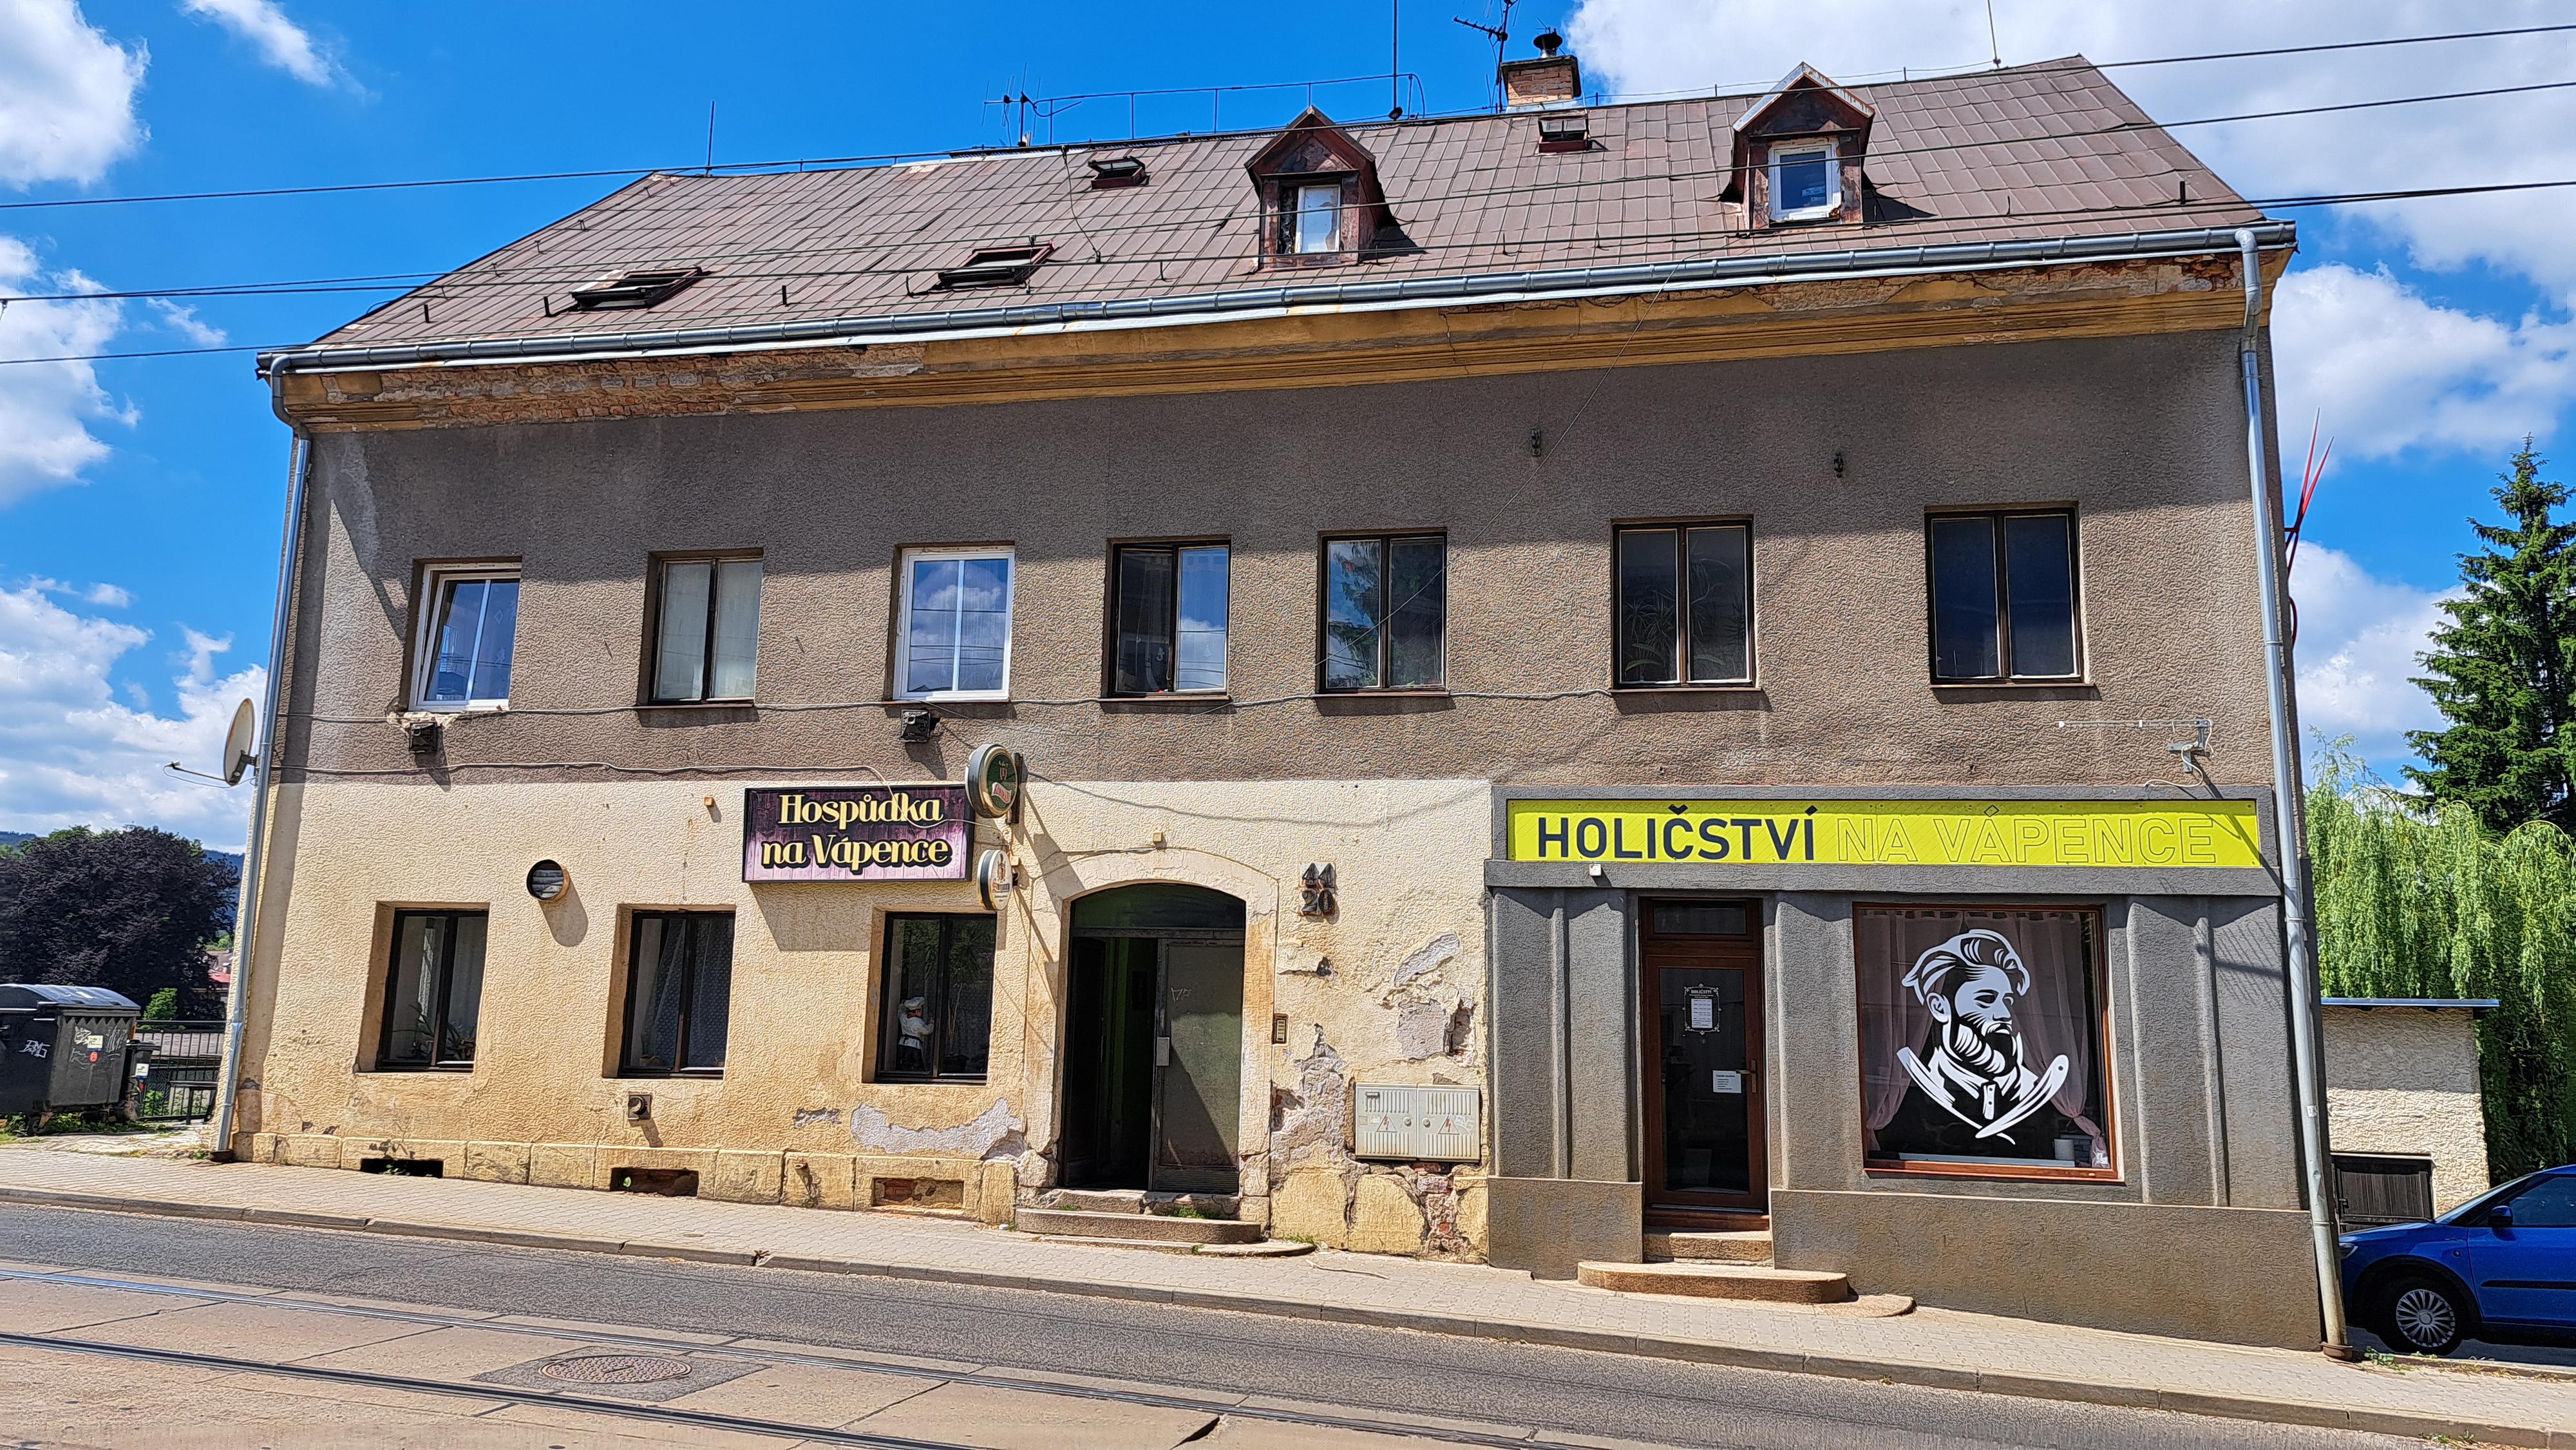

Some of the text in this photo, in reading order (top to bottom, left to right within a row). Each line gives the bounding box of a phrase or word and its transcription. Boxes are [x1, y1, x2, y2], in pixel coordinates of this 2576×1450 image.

[777, 793, 943, 829] Hospůdka
[1538, 804, 2216, 863] HOLIČSTVÍ NA VÁPENCE
[762, 834, 949, 871] na Vápence
